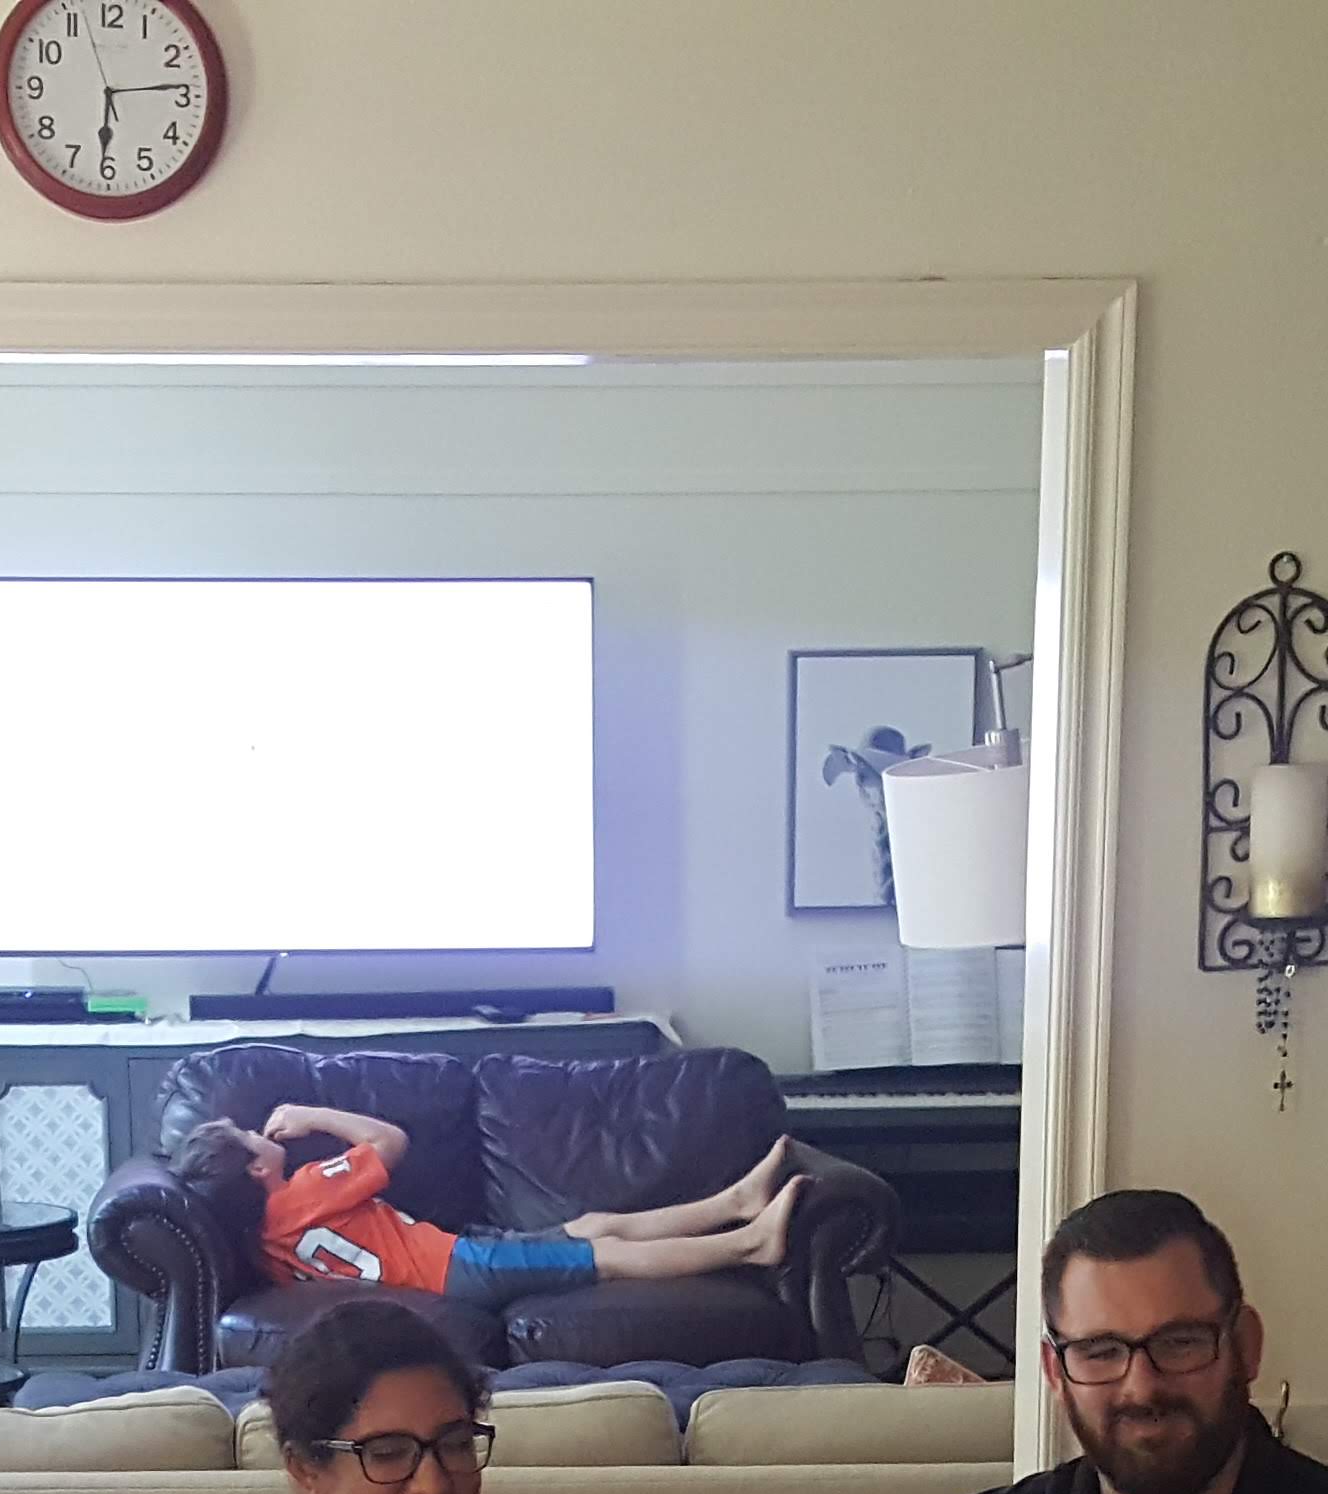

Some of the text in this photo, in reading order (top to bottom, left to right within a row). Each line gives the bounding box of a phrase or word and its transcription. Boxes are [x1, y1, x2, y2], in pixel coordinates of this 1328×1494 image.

[67, 12, 78, 37] 11
[100, 4, 123, 28] 12
[141, 14, 148, 39] 1
[38, 39, 62, 65] 10
[164, 44, 181, 68] 2
[27, 76, 44, 99] 9
[174, 84, 191, 108] 3
[37, 116, 55, 139] 8
[163, 121, 180, 145] 4
[65, 145, 81, 169] 7
[99, 156, 116, 180] 6
[136, 148, 154, 171] 5
